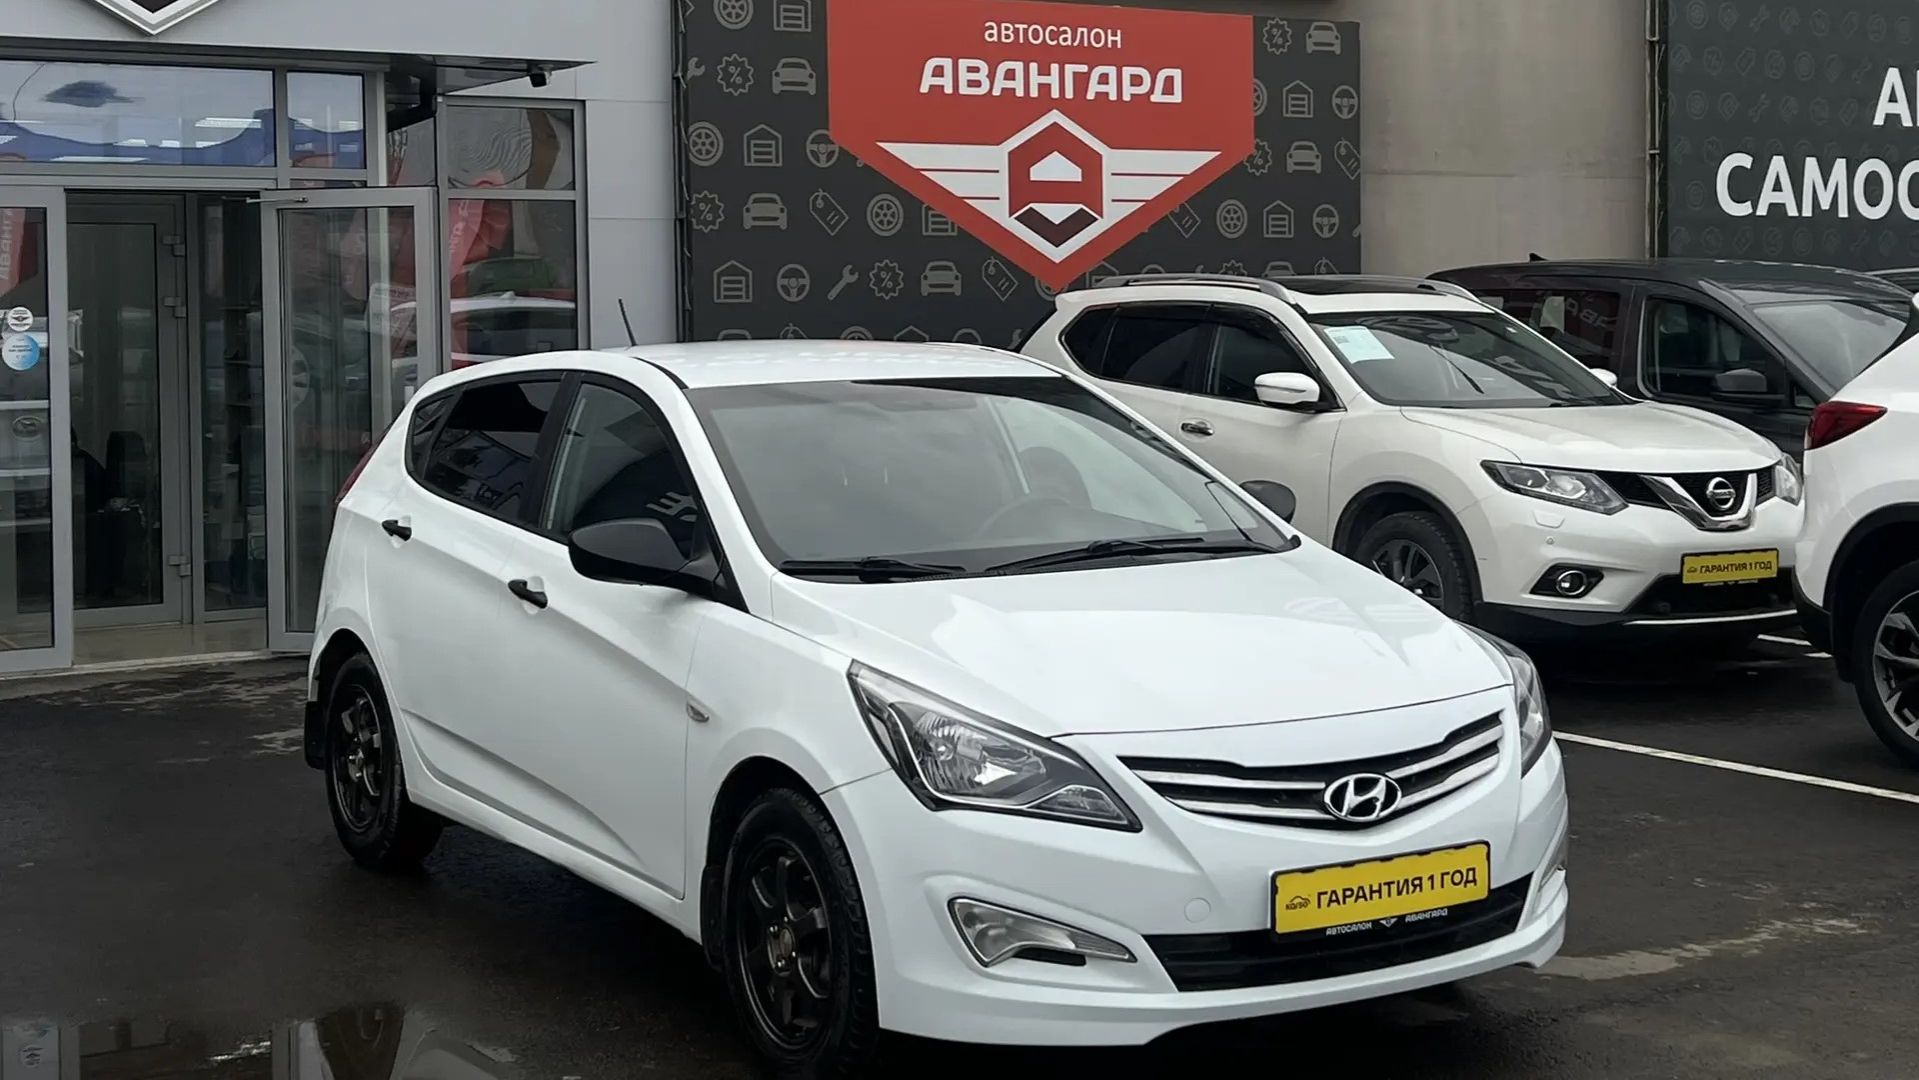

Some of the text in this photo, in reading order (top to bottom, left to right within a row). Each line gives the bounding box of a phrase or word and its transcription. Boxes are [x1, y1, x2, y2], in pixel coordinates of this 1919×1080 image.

[984, 21, 1122, 49] автосалон
[919, 57, 1182, 104] АВАНГАРД
[1700, 562, 1747, 574] ГАРАНТИЯ
[1754, 561, 1772, 571] ГОД
[1316, 867, 1478, 909] ГАРАНТИЯ 1 ГОД
[1326, 908, 1448, 936] АВТОСАЛОН АВАНГАРД
